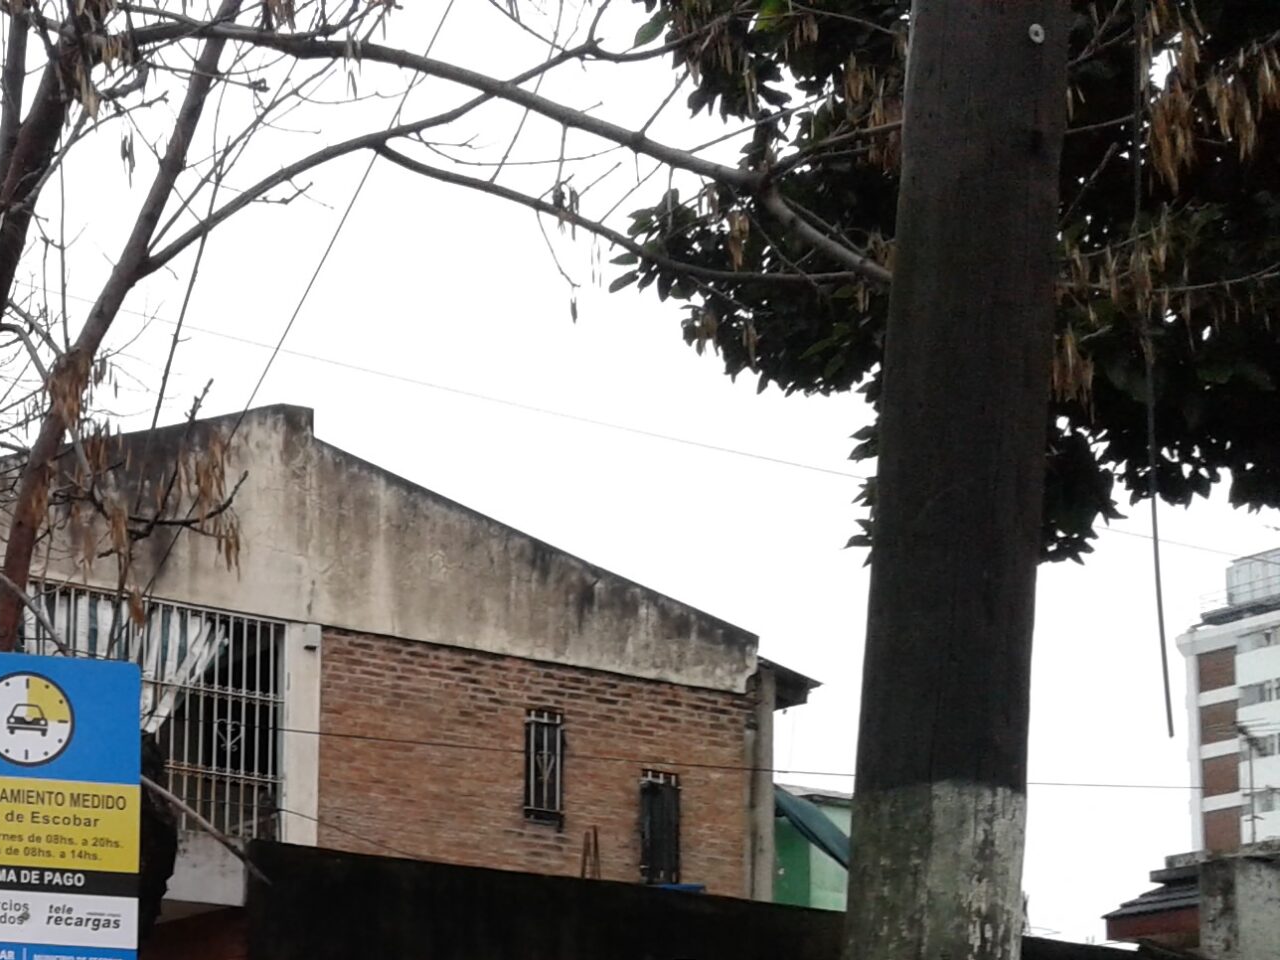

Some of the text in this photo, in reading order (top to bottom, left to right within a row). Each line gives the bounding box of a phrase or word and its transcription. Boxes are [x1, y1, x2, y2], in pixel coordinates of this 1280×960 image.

[69, 792, 127, 811] MEDIDO
[4, 810, 24, 823] de
[30, 811, 100, 827] Escobar
[27, 833, 42, 844] de
[81, 838, 89, 846] a
[5, 846, 20, 856] de
[59, 850, 66, 859] a
[20, 870, 40, 884] DE
[43, 871, 85, 887] PAGO
[48, 904, 73, 915] tele
[46, 915, 121, 932] recargas
